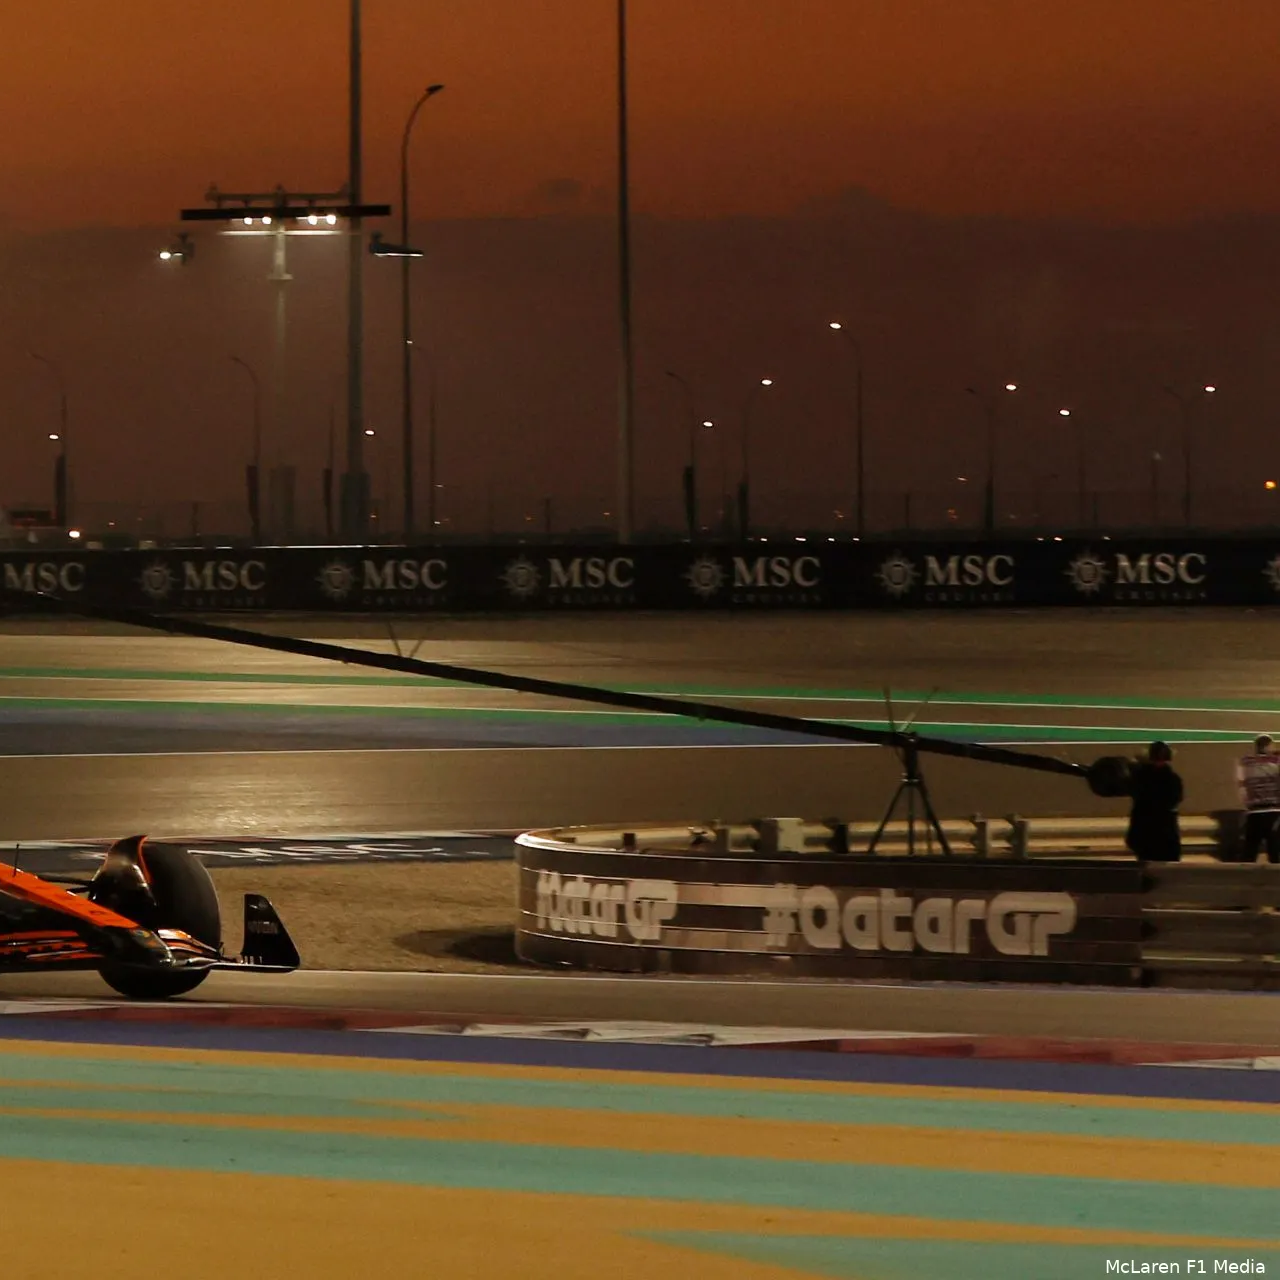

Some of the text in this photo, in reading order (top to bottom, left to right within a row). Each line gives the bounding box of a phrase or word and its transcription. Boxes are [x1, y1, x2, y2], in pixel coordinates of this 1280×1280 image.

[4, 562, 85, 591] MSC
[184, 561, 265, 590] MSC
[363, 560, 447, 589] MSC
[549, 558, 634, 588] MSC
[734, 556, 819, 587] MSC
[925, 555, 1014, 585] MSC
[1115, 553, 1206, 584] MSC
[762, 883, 1076, 956] #QatarGP
